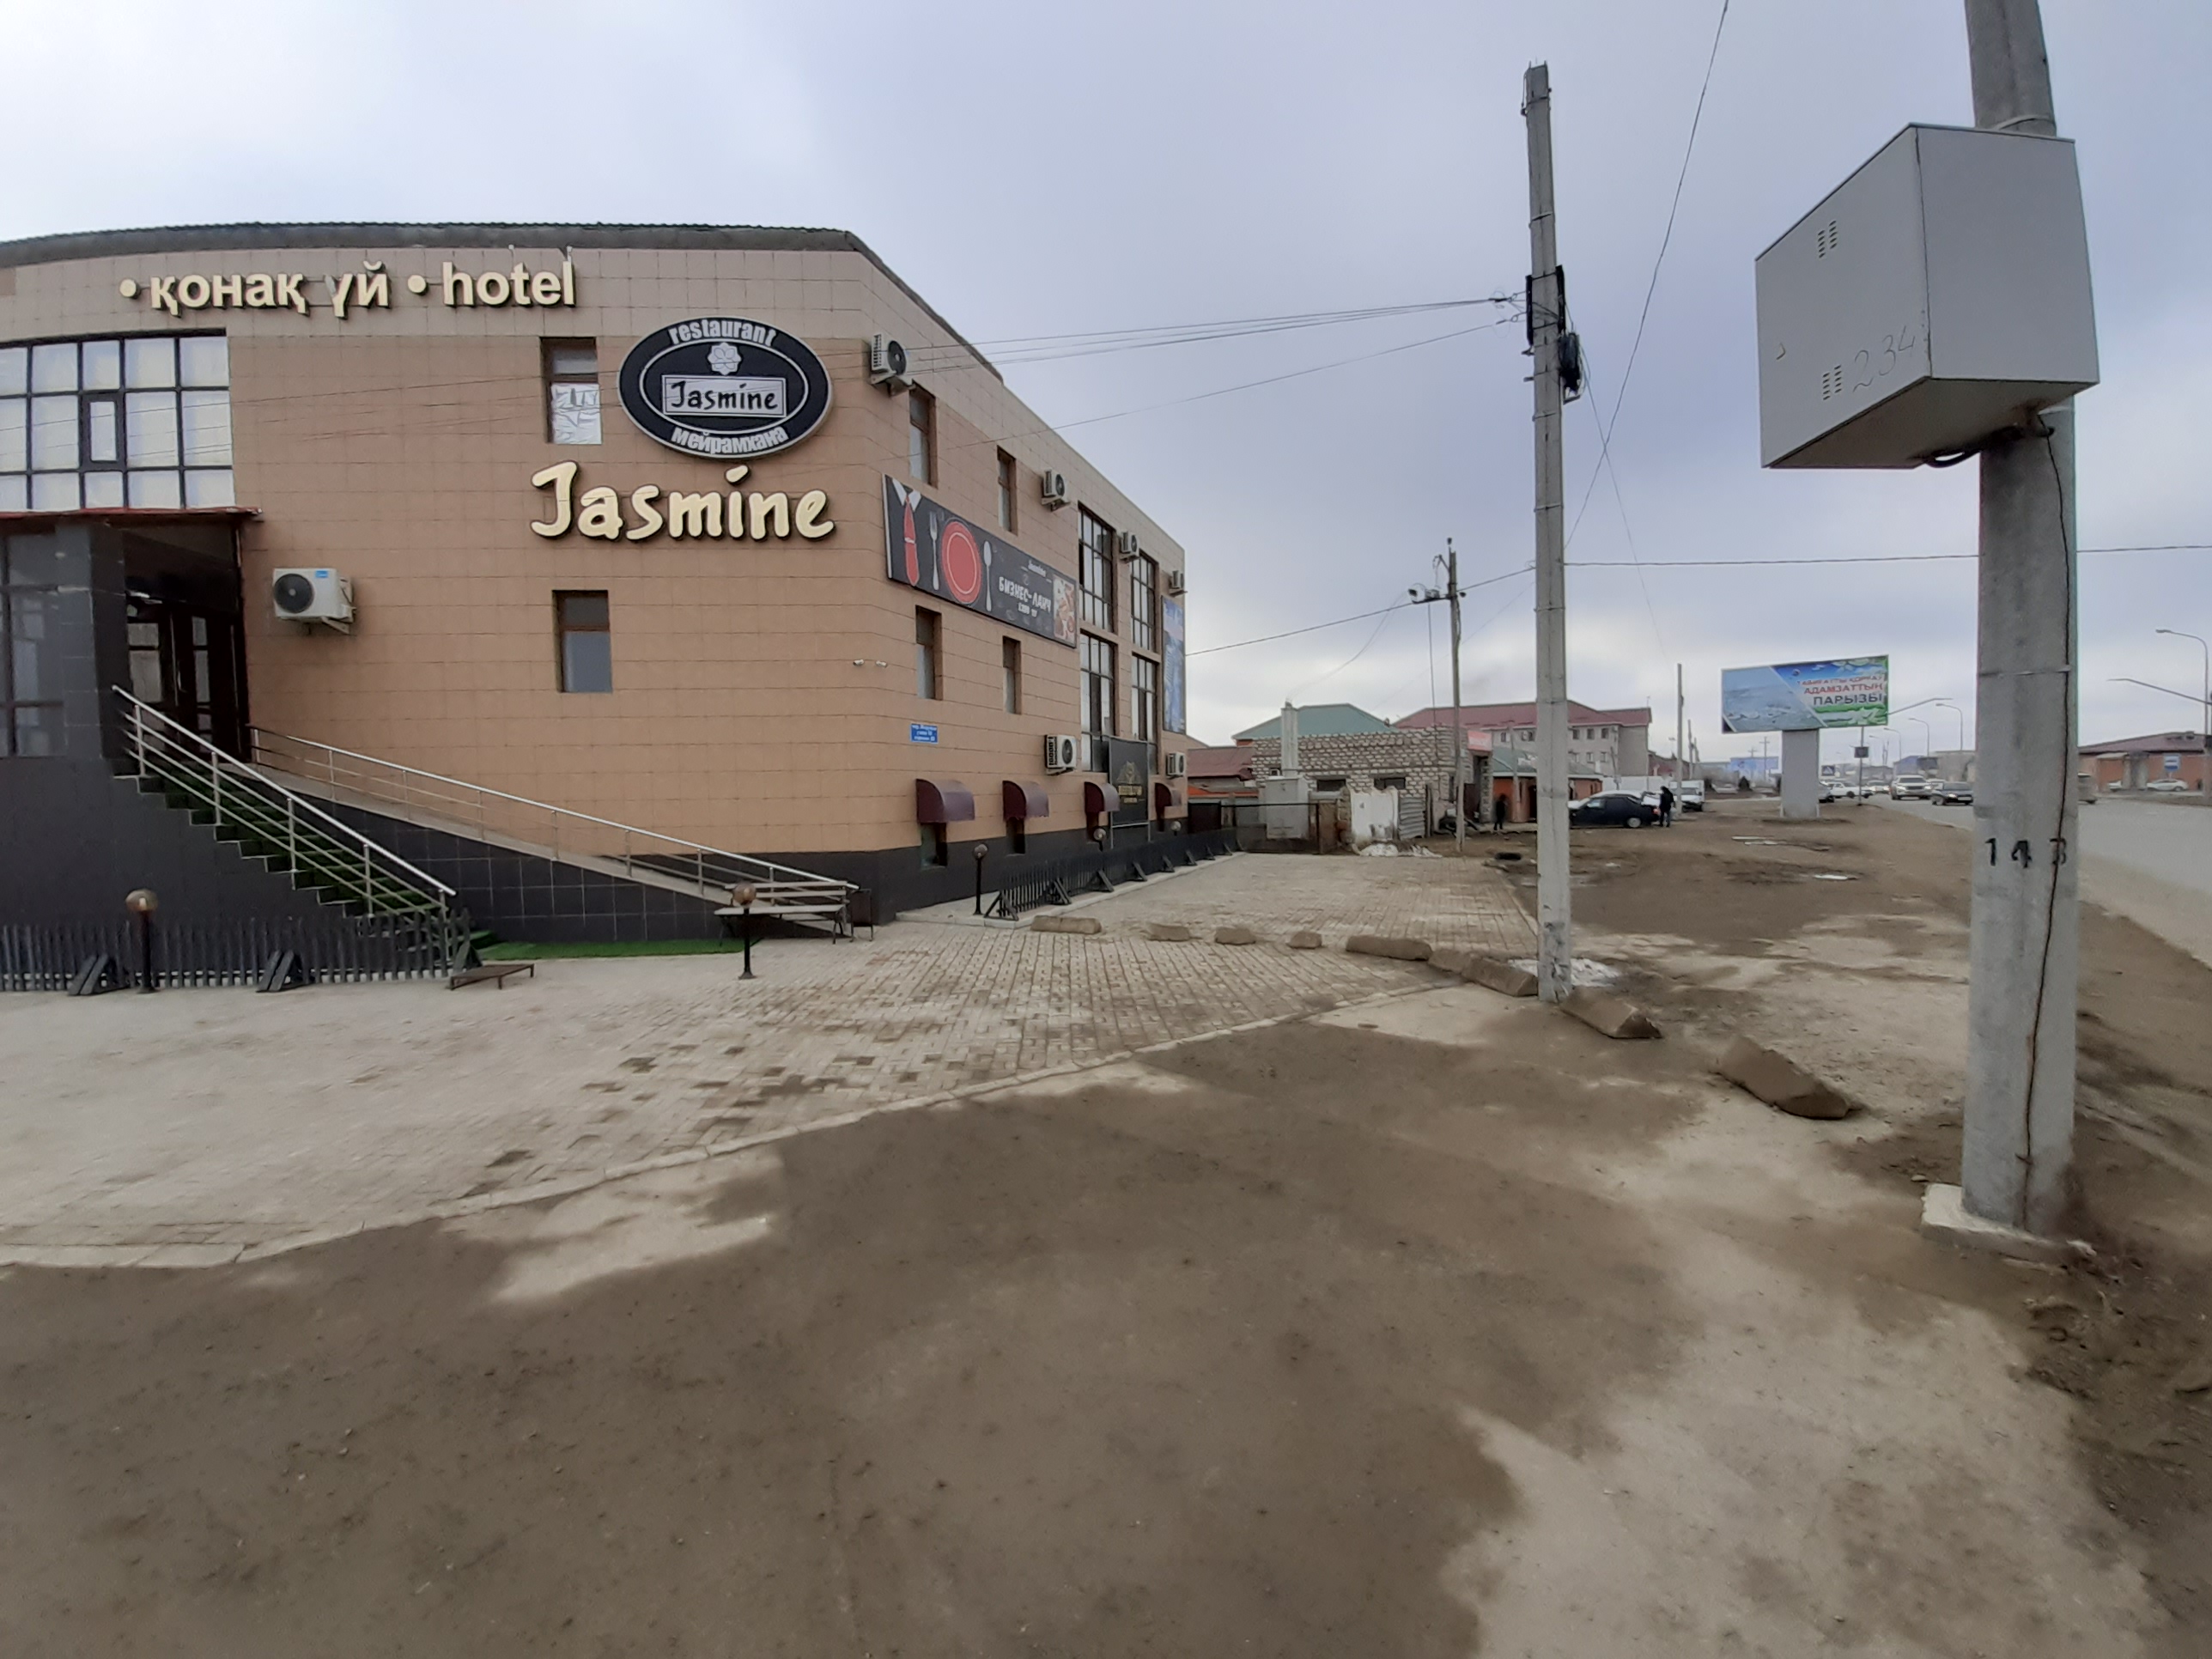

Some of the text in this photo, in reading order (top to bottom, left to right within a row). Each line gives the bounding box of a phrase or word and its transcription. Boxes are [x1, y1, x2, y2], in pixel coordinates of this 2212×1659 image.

[442, 258, 577, 307] hotel
[668, 319, 776, 347] restaurant
[1852, 325, 1916, 393] 234
[671, 380, 778, 411] Jasmine
[530, 459, 836, 541] Jasmine
[1813, 693, 1882, 705] ПАРЫЗЫ
